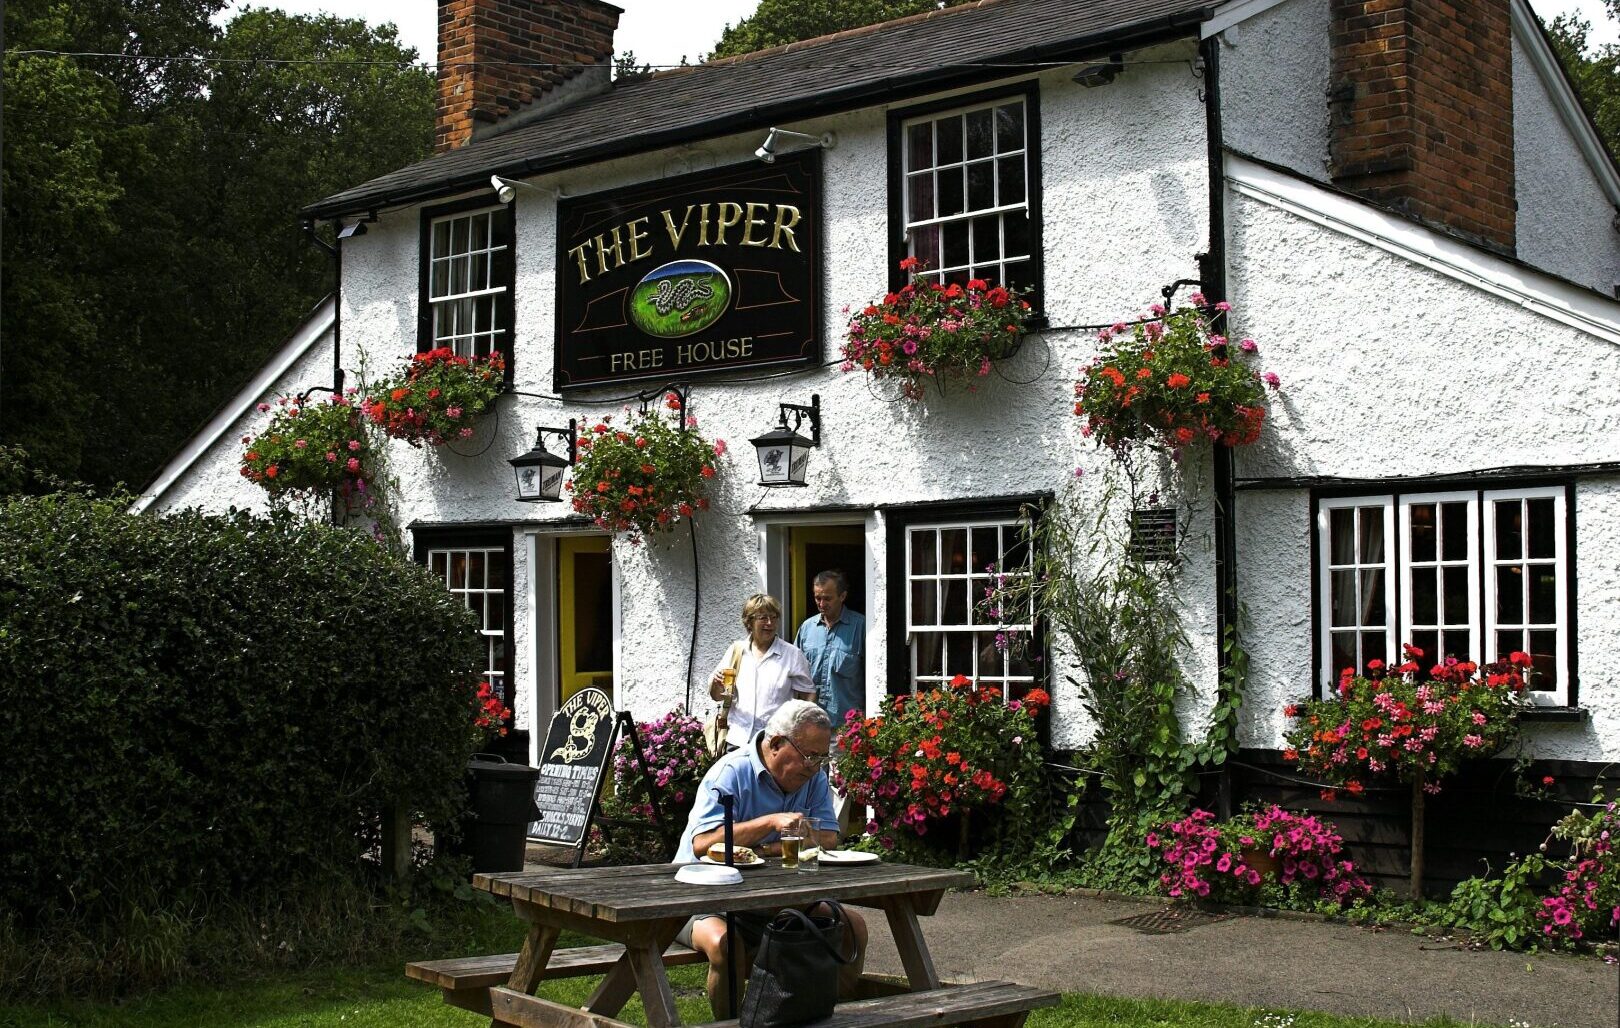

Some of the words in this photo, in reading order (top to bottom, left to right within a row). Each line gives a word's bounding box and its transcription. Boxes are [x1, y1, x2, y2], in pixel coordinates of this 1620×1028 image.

[568, 216, 653, 285] THE
[661, 202, 802, 253] VIPER
[610, 349, 664, 372] FREE
[677, 337, 753, 365] HOUSE
[562, 693, 584, 718] THE
[586, 691, 610, 721] VIPER
[541, 763, 572, 779] OPENING
[572, 765, 599, 780] TIMES
[531, 821, 553, 837] DAILY
